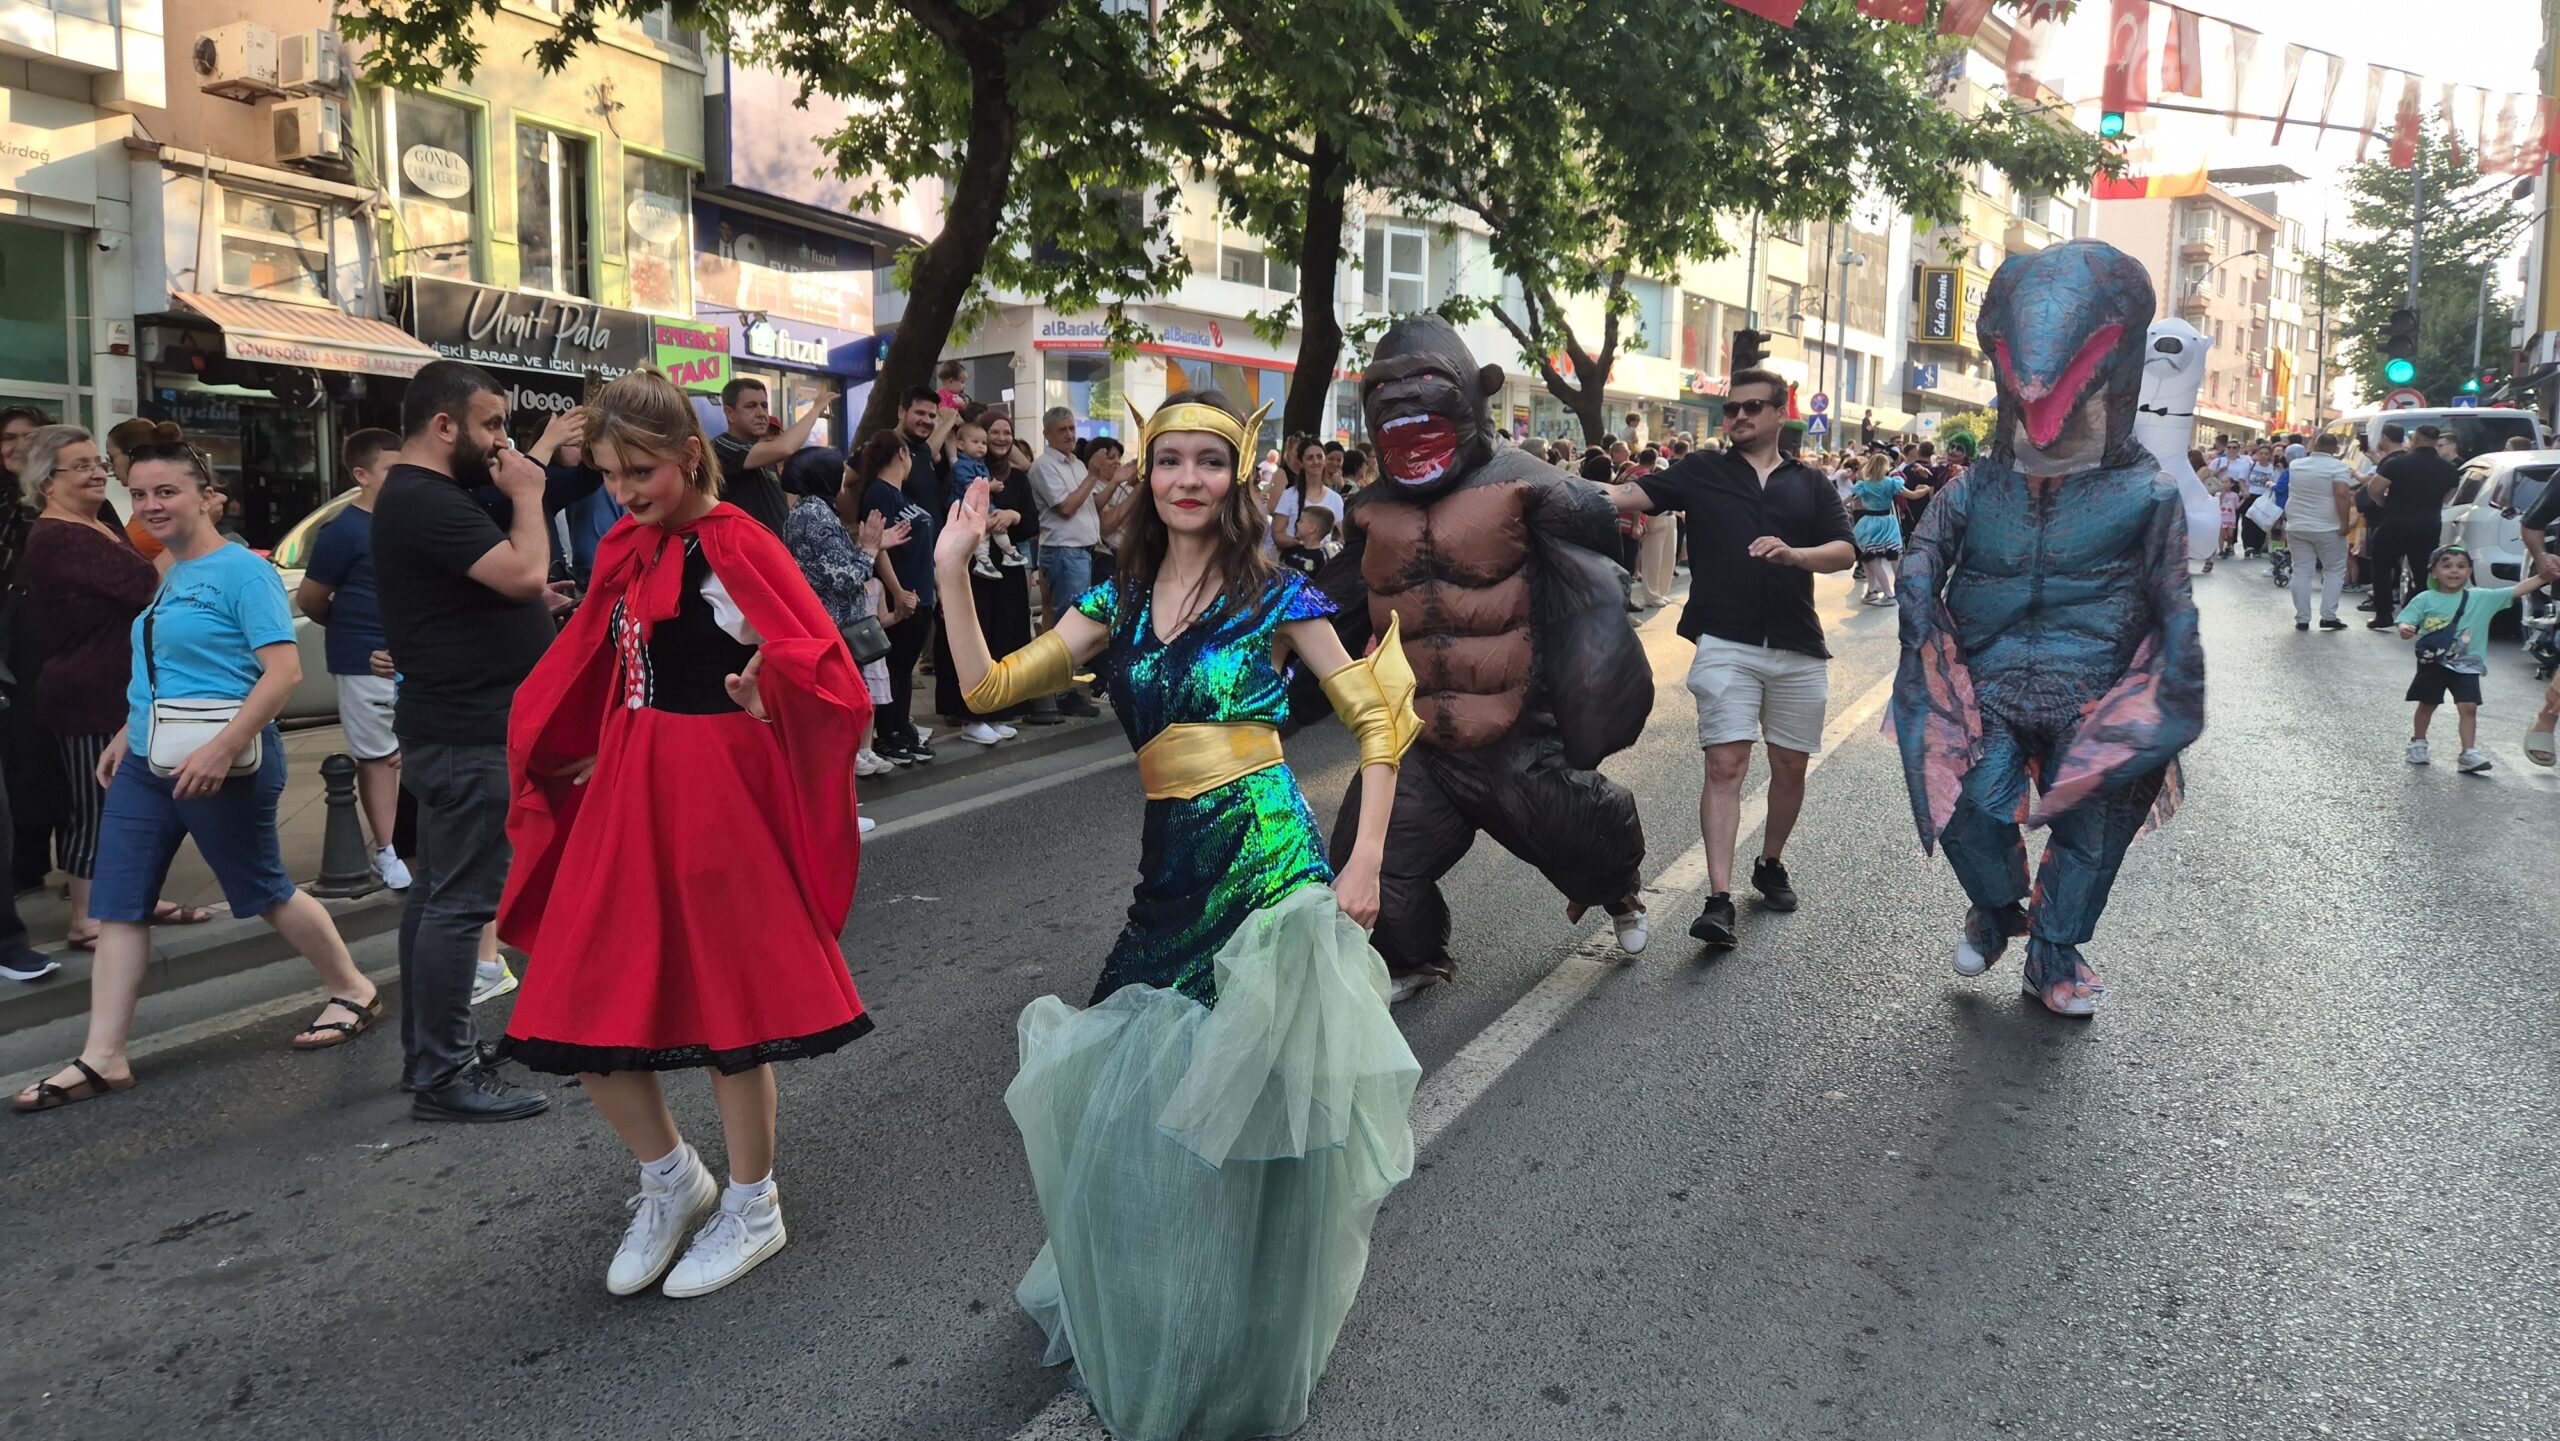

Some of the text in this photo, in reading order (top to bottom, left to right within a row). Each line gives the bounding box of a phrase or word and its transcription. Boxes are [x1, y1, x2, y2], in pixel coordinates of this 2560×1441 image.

[811, 249, 836, 267] fuzul
[1933, 273, 1948, 336] Eda Demir
[553, 303, 611, 358] Pala
[1042, 321, 1109, 336] alBaraka
[1163, 326, 1211, 347] alBaraka
[777, 328, 829, 366] fuzul
[469, 348, 518, 365] ŞARAP
[523, 356, 542, 368] VE
